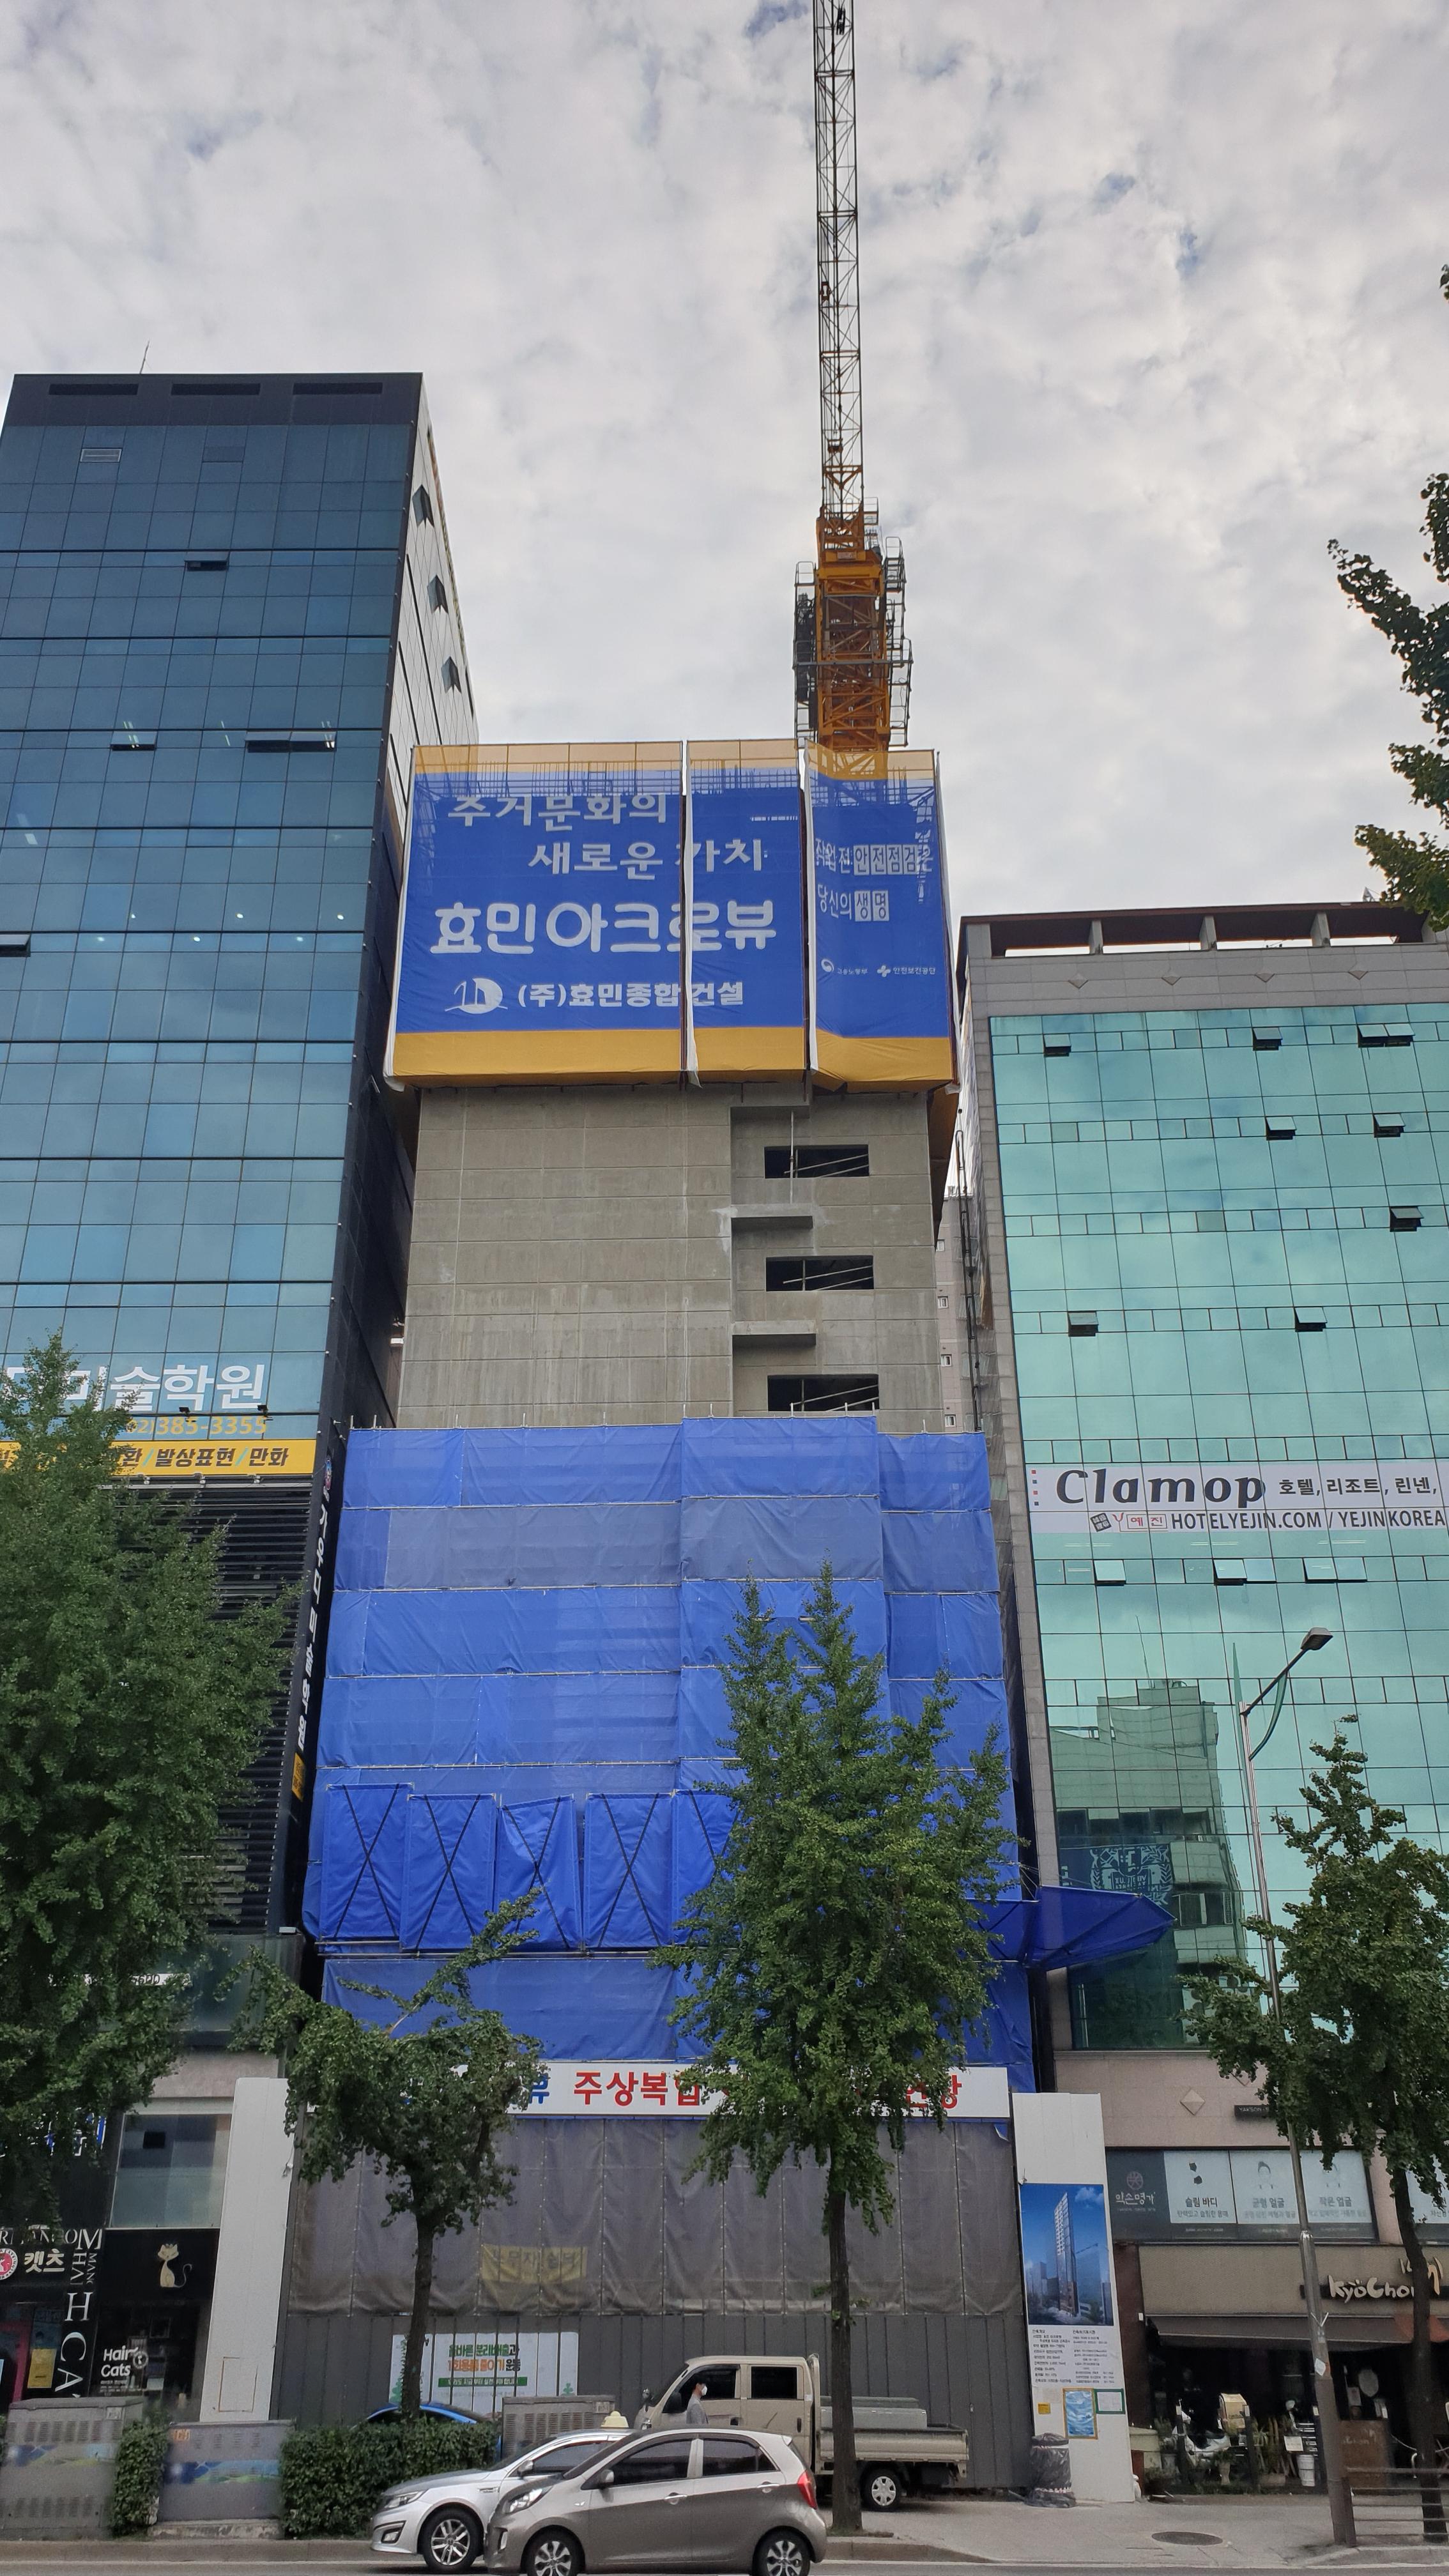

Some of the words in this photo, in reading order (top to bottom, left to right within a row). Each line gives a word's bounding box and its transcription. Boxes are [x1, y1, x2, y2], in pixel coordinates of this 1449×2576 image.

[448, 793, 666, 831] 주거문화의
[528, 841, 663, 880] 새로운
[675, 839, 763, 872] 가치
[818, 884, 852, 920] 당신의
[854, 890, 889, 921] 생명
[893, 967, 936, 975] 안전보건공단
[518, 980, 745, 1008] (주)효민종합건설
[1056, 1468, 1266, 1508] Clamop
[1171, 1512, 1321, 1530] HOTELYEJIN.COM
[1340, 1508, 1446, 1528] YEJINKOREA
[1115, 2191, 1156, 2206] 약손명가
[1185, 2196, 1200, 2207] 슬림
[1202, 2196, 1218, 2207] 바디
[24, 2248, 65, 2273] 캣츠
[103, 2345, 139, 2361] Hair
[101, 2363, 132, 2377] Cats
